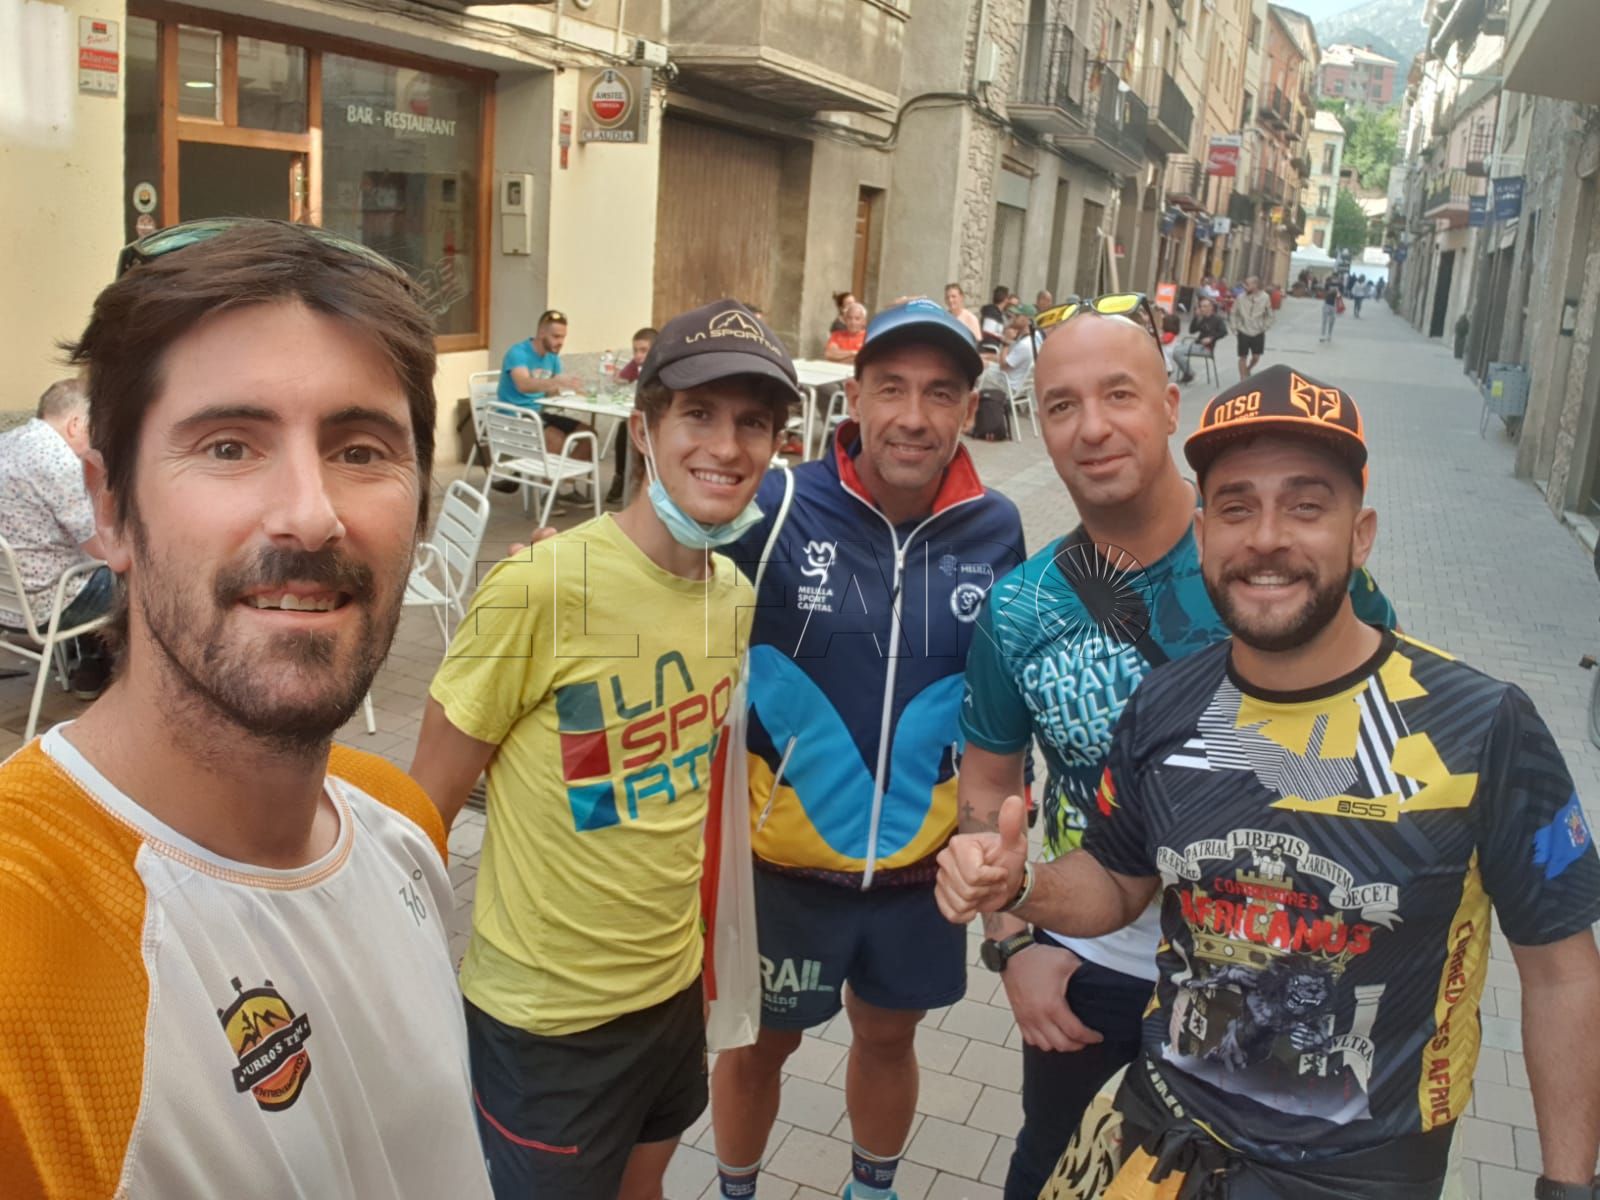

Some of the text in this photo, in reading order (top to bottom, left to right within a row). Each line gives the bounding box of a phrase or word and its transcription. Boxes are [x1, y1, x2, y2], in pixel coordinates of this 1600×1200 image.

[596, 91, 624, 100] AMSTEL
[346, 104, 374, 125] BAR
[384, 110, 457, 137] RESTAURANT
[685, 328, 783, 358] LA SPORTIVA
[1214, 391, 1261, 424] OTSO
[796, 602, 833, 613] CAPITAL
[797, 594, 827, 604] SPORT
[798, 585, 834, 597] MELILLA
[610, 650, 695, 720] LA
[1039, 645, 1151, 708] TRAVE
[1185, 840, 1231, 863] PATRIAM
[1233, 831, 1304, 857] LIBERIS
[1302, 855, 1352, 894] PARENTEM
[1341, 885, 1392, 908] DECET
[1180, 889, 1373, 955] AFRICANUS
[1428, 1057, 1451, 1124] AFRIC
